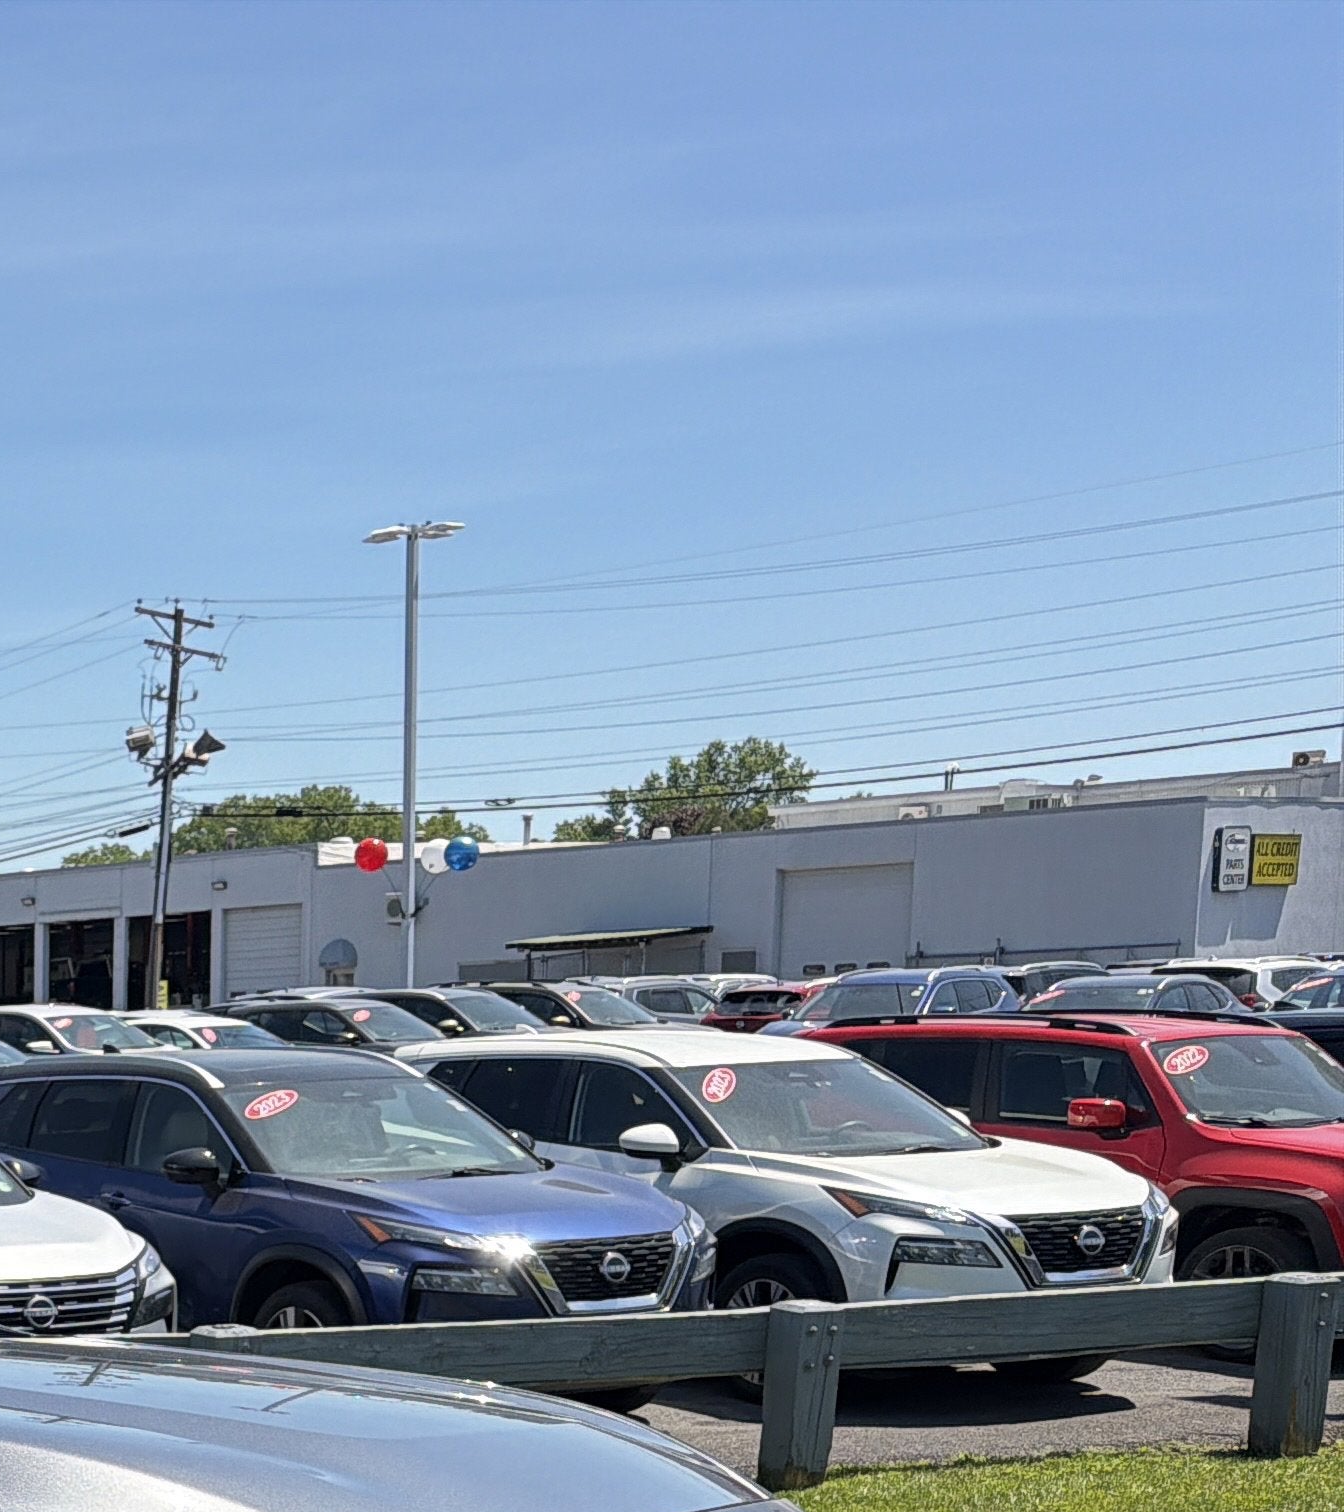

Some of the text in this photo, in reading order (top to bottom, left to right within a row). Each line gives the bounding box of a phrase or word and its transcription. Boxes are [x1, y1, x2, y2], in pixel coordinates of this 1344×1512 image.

[1256, 841, 1270, 856] ALL
[1271, 841, 1299, 857] CREDIT
[1226, 858, 1244, 870] PARTS
[1256, 861, 1294, 877] ACCEPTED
[1222, 873, 1245, 885] CENTER
[1170, 1048, 1203, 1071] 2022
[253, 1091, 292, 1116] 2023
